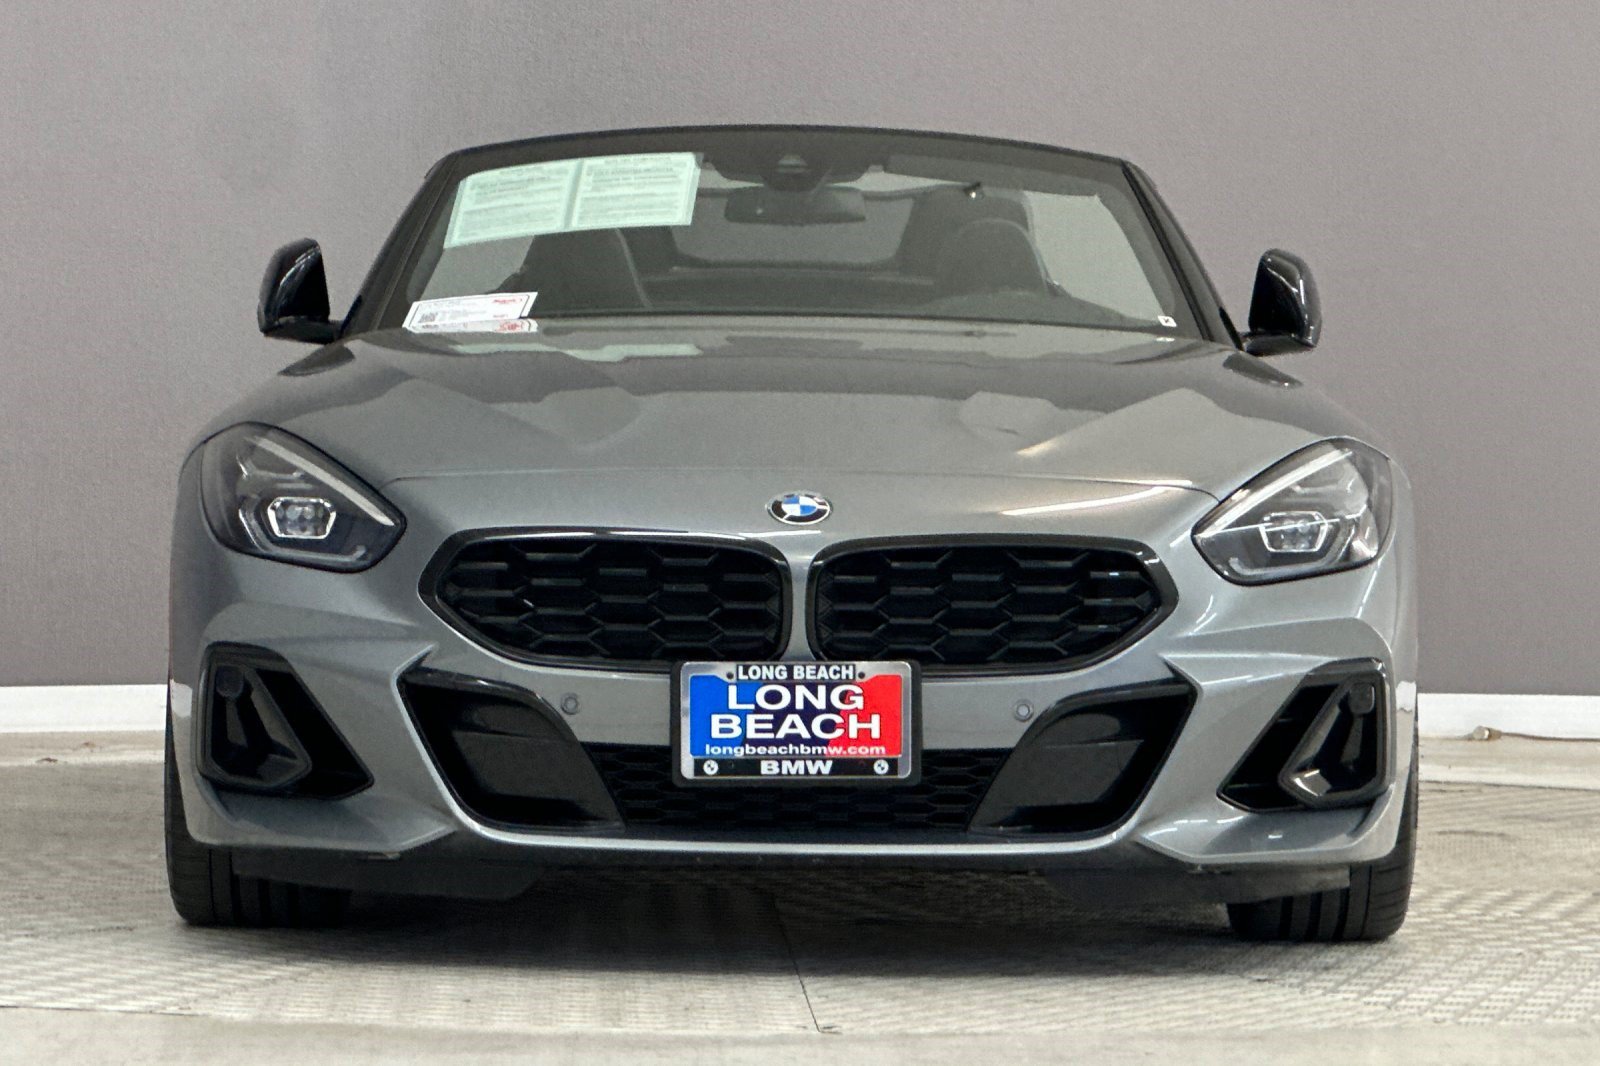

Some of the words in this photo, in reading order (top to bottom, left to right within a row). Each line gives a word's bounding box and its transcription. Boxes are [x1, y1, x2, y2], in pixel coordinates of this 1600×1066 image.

[738, 665, 788, 680] LONG
[793, 665, 854, 680] BEACH
[728, 684, 864, 710] LONG
[711, 714, 880, 738] BEACH
[705, 743, 886, 756] longbeachbmw.com
[760, 759, 833, 775] BMW
